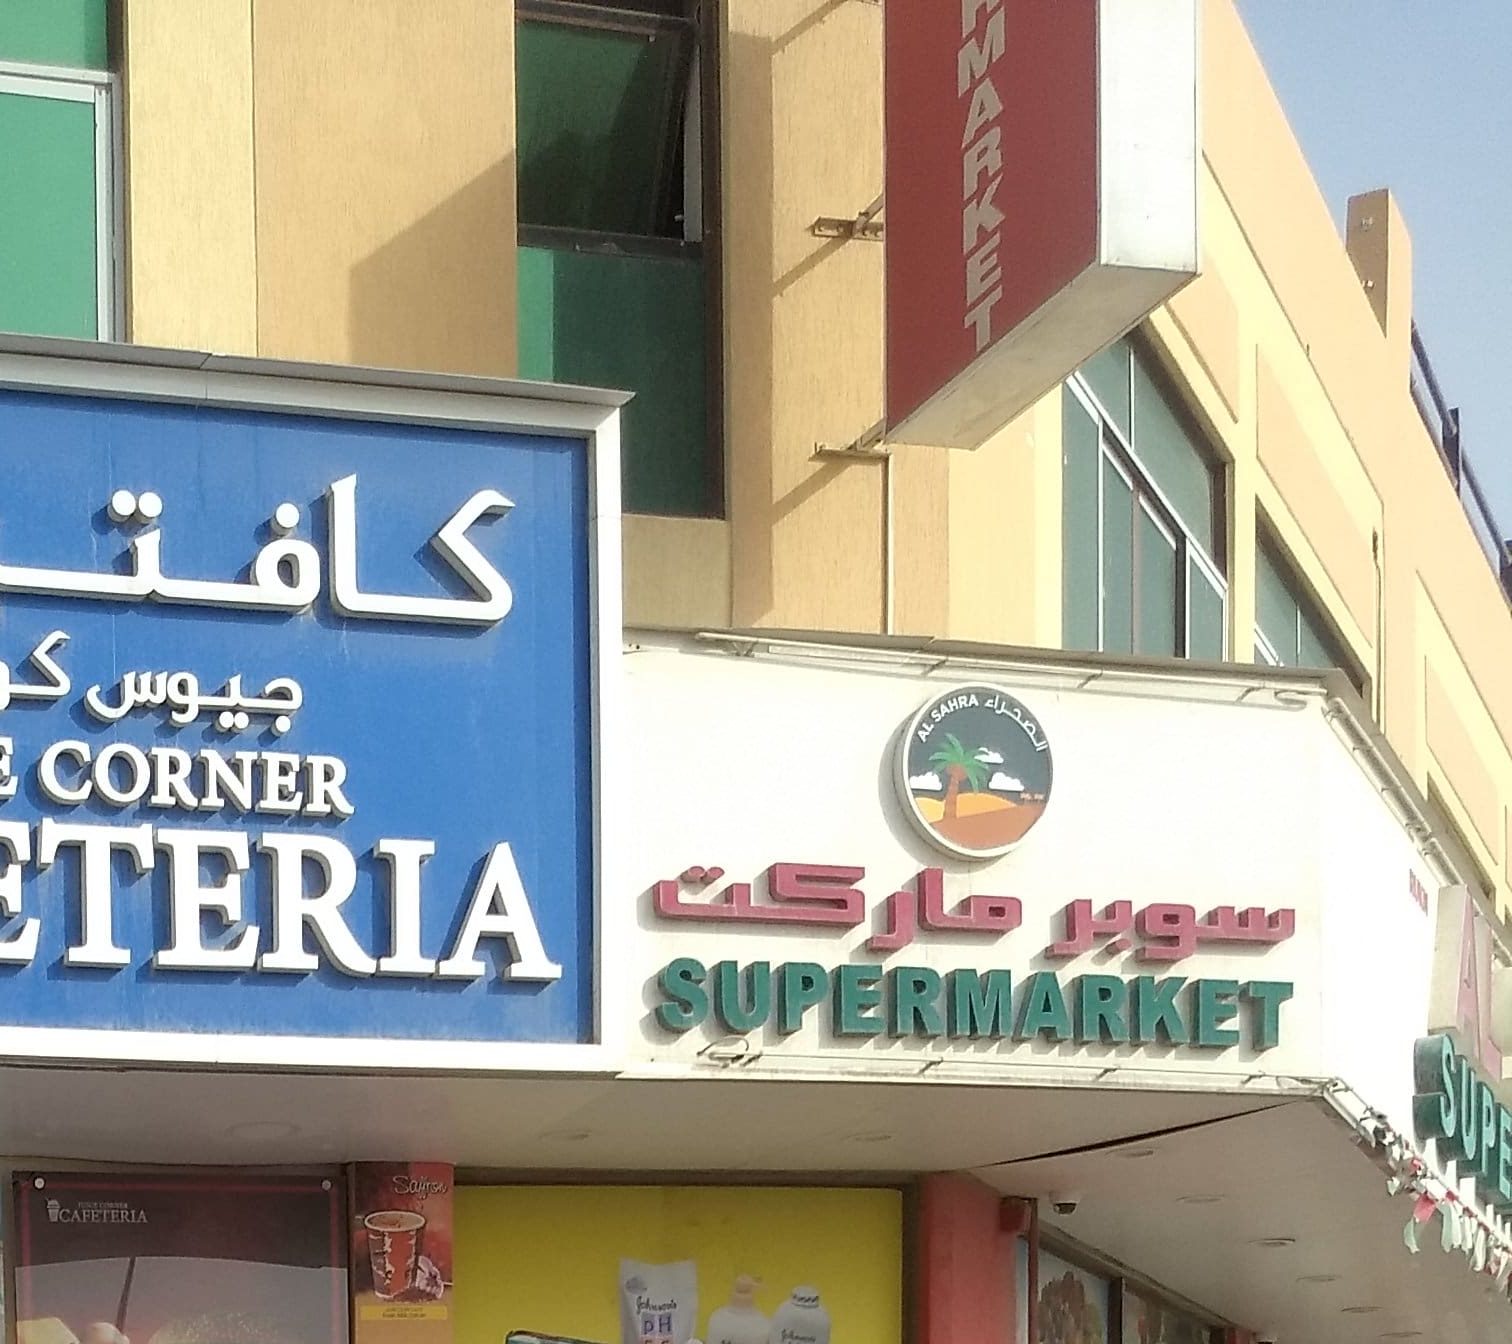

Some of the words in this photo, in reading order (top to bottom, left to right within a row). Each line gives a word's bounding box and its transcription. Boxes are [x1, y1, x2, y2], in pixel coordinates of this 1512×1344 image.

[87, 664, 304, 734] جيوس
[917, 722, 935, 743] AL
[931, 694, 979, 722] SAHRA
[985, 695, 1049, 752] الصحراء
[40, 738, 355, 816] CORNER
[652, 862, 1024, 953] ماركت
[1047, 896, 1296, 963] سوبر
[657, 957, 1294, 1050] SUPERMARKET
[59, 1208, 148, 1223] CAFETERIA
